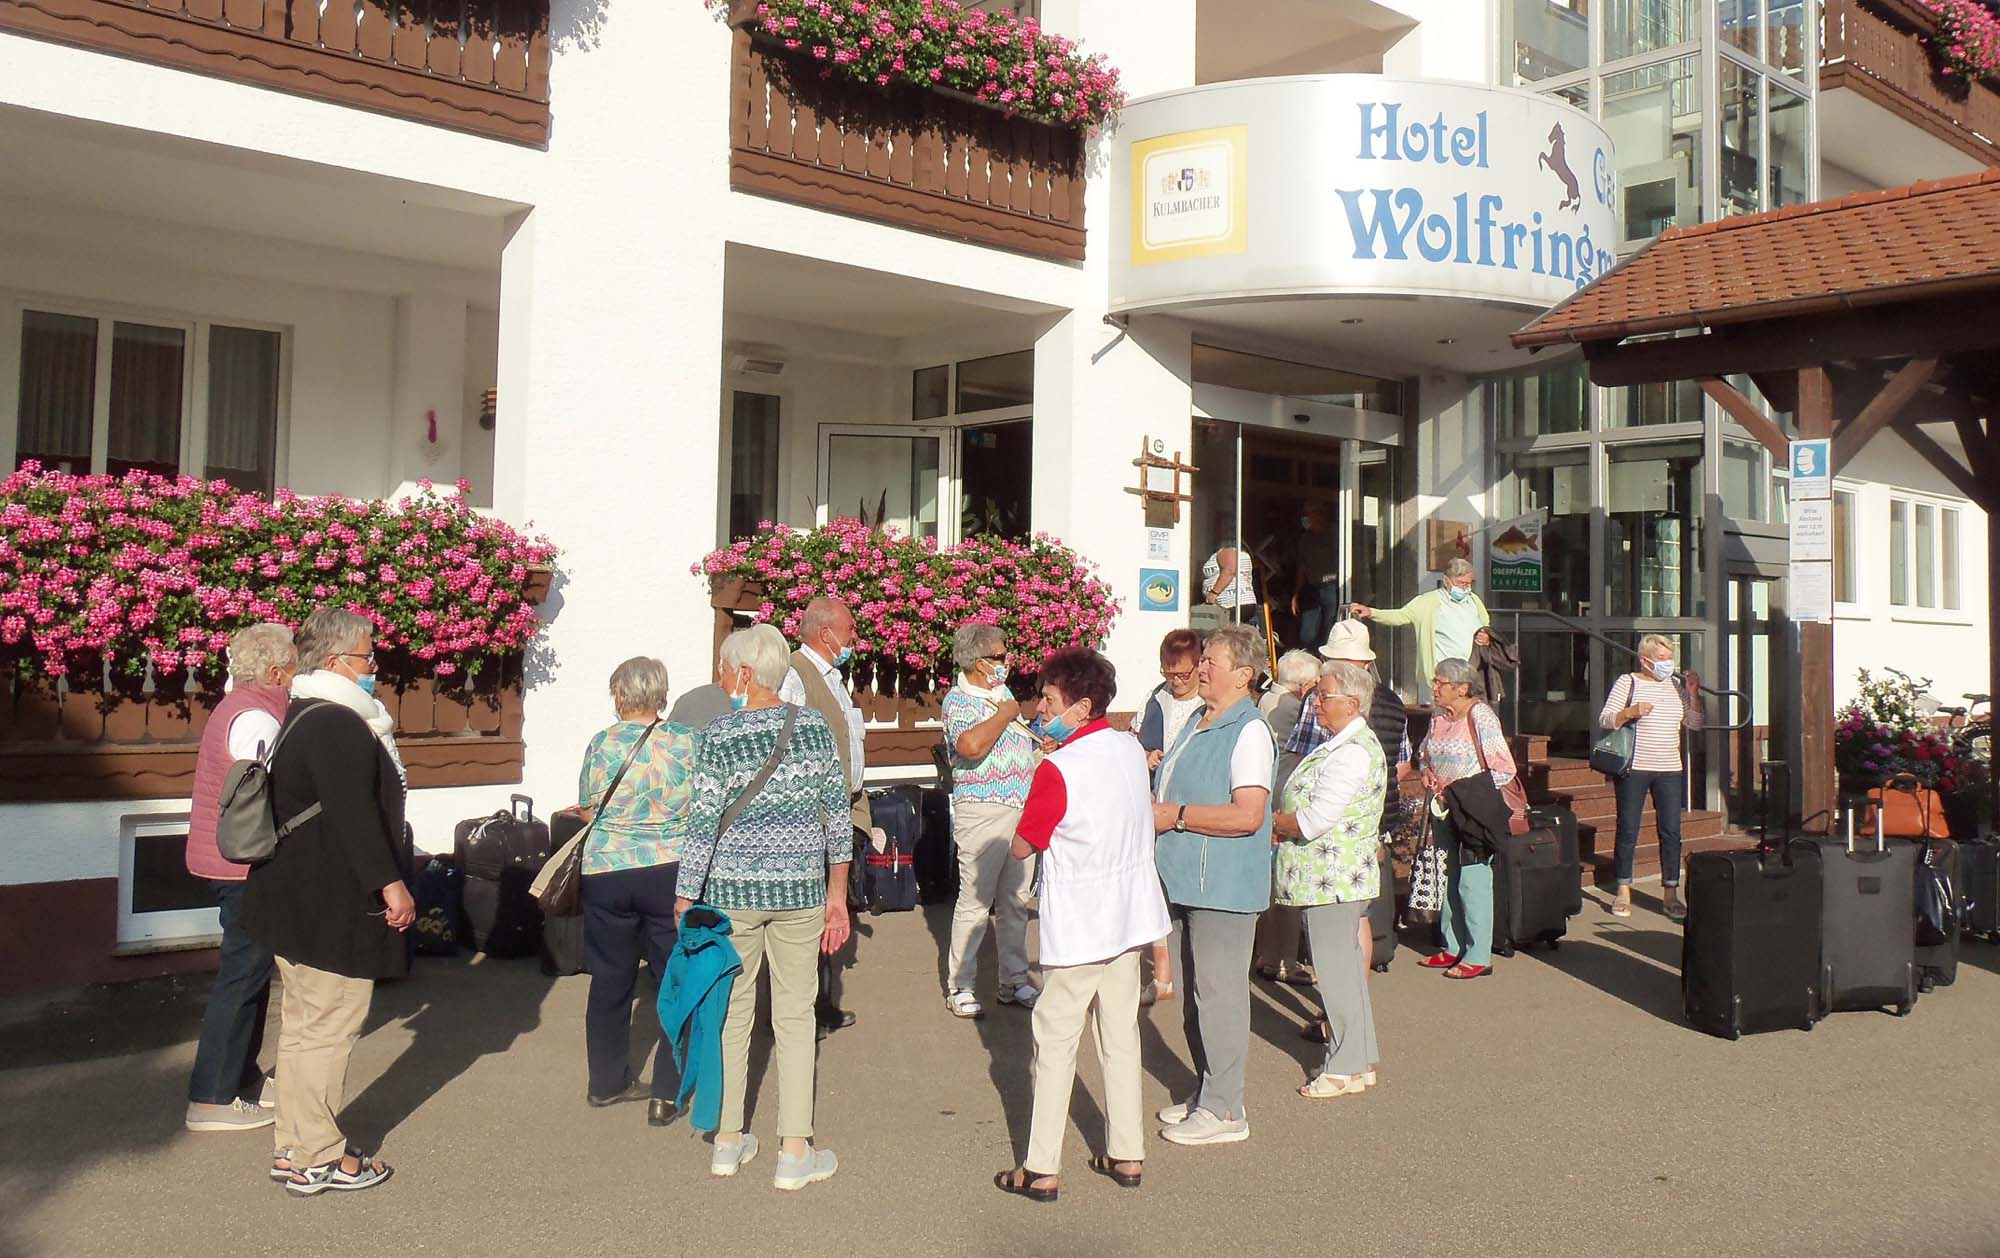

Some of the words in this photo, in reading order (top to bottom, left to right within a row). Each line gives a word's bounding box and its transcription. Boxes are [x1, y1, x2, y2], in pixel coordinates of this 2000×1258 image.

[1355, 101, 1490, 169] Hotel
[1153, 195, 1221, 217] KULMBACHER
[1334, 187, 1616, 289] Wolfringm
